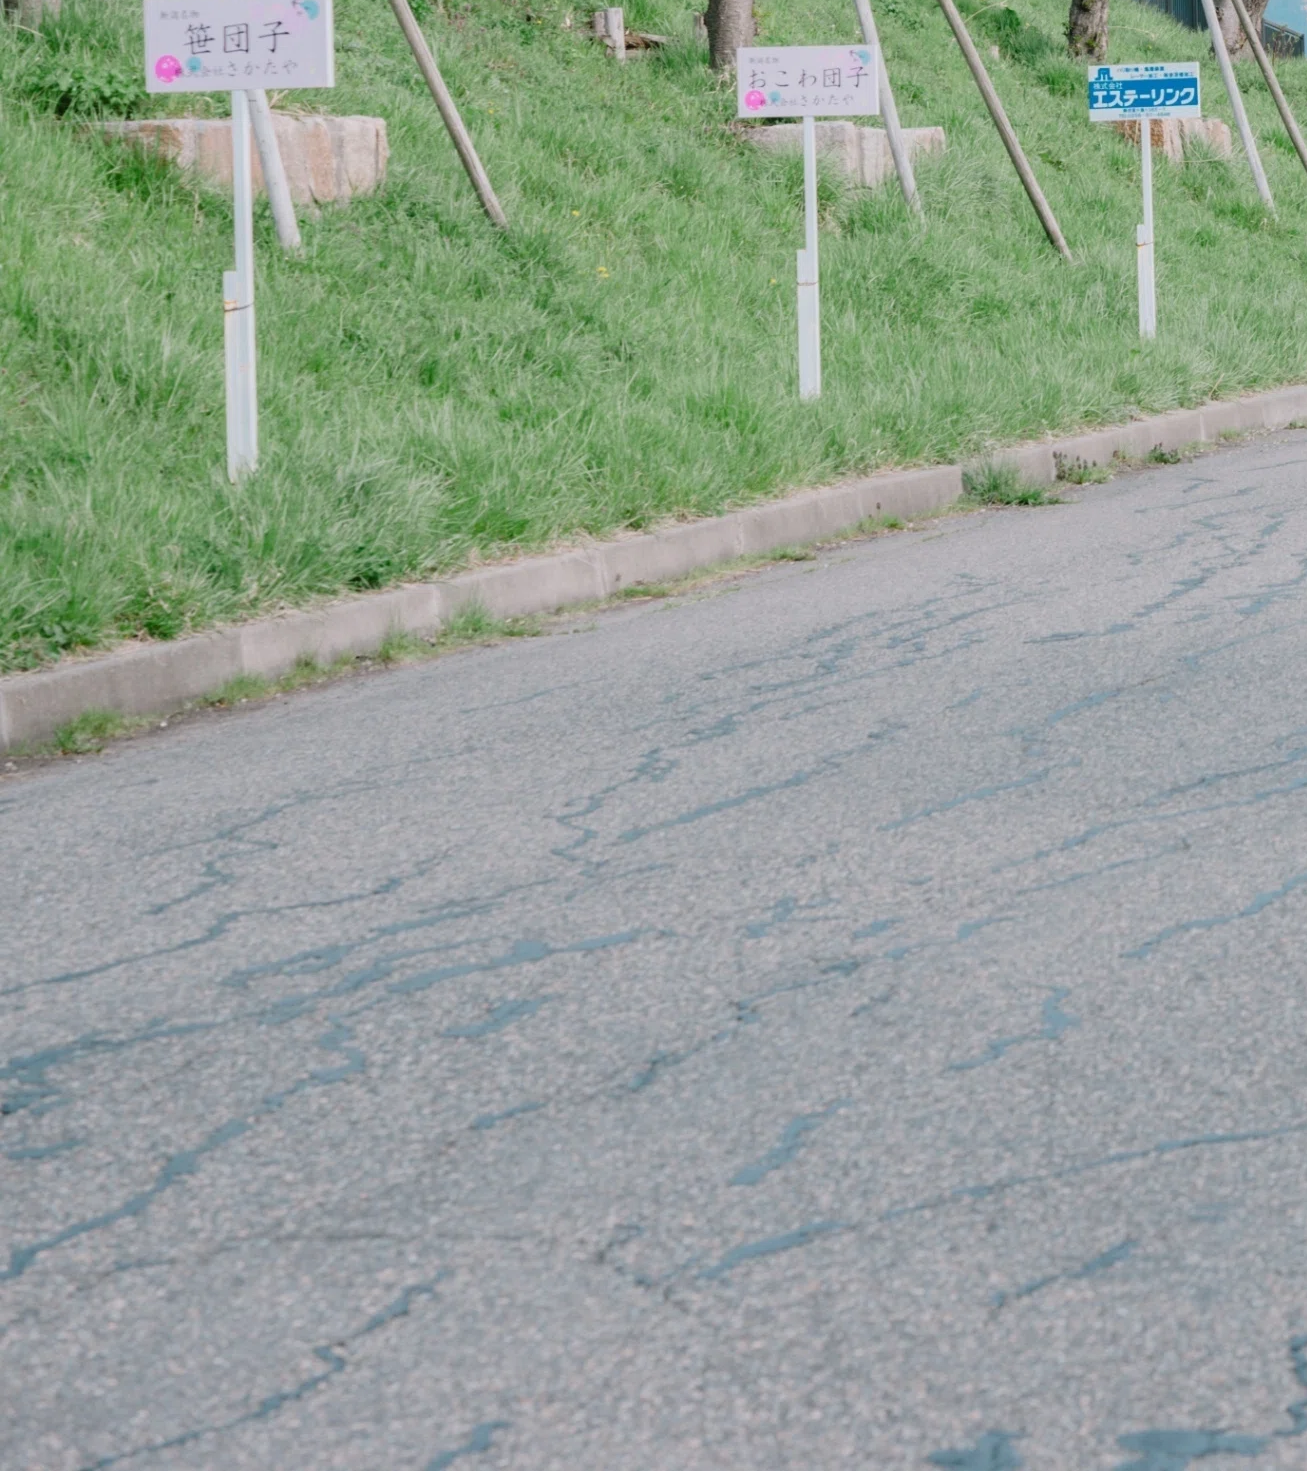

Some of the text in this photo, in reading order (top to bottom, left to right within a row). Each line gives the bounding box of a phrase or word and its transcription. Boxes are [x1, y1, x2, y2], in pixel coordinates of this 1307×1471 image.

[184, 20, 290, 56] 笹団子
[748, 66, 869, 90] おこわ団子
[1092, 87, 1195, 108] エステーリンク
